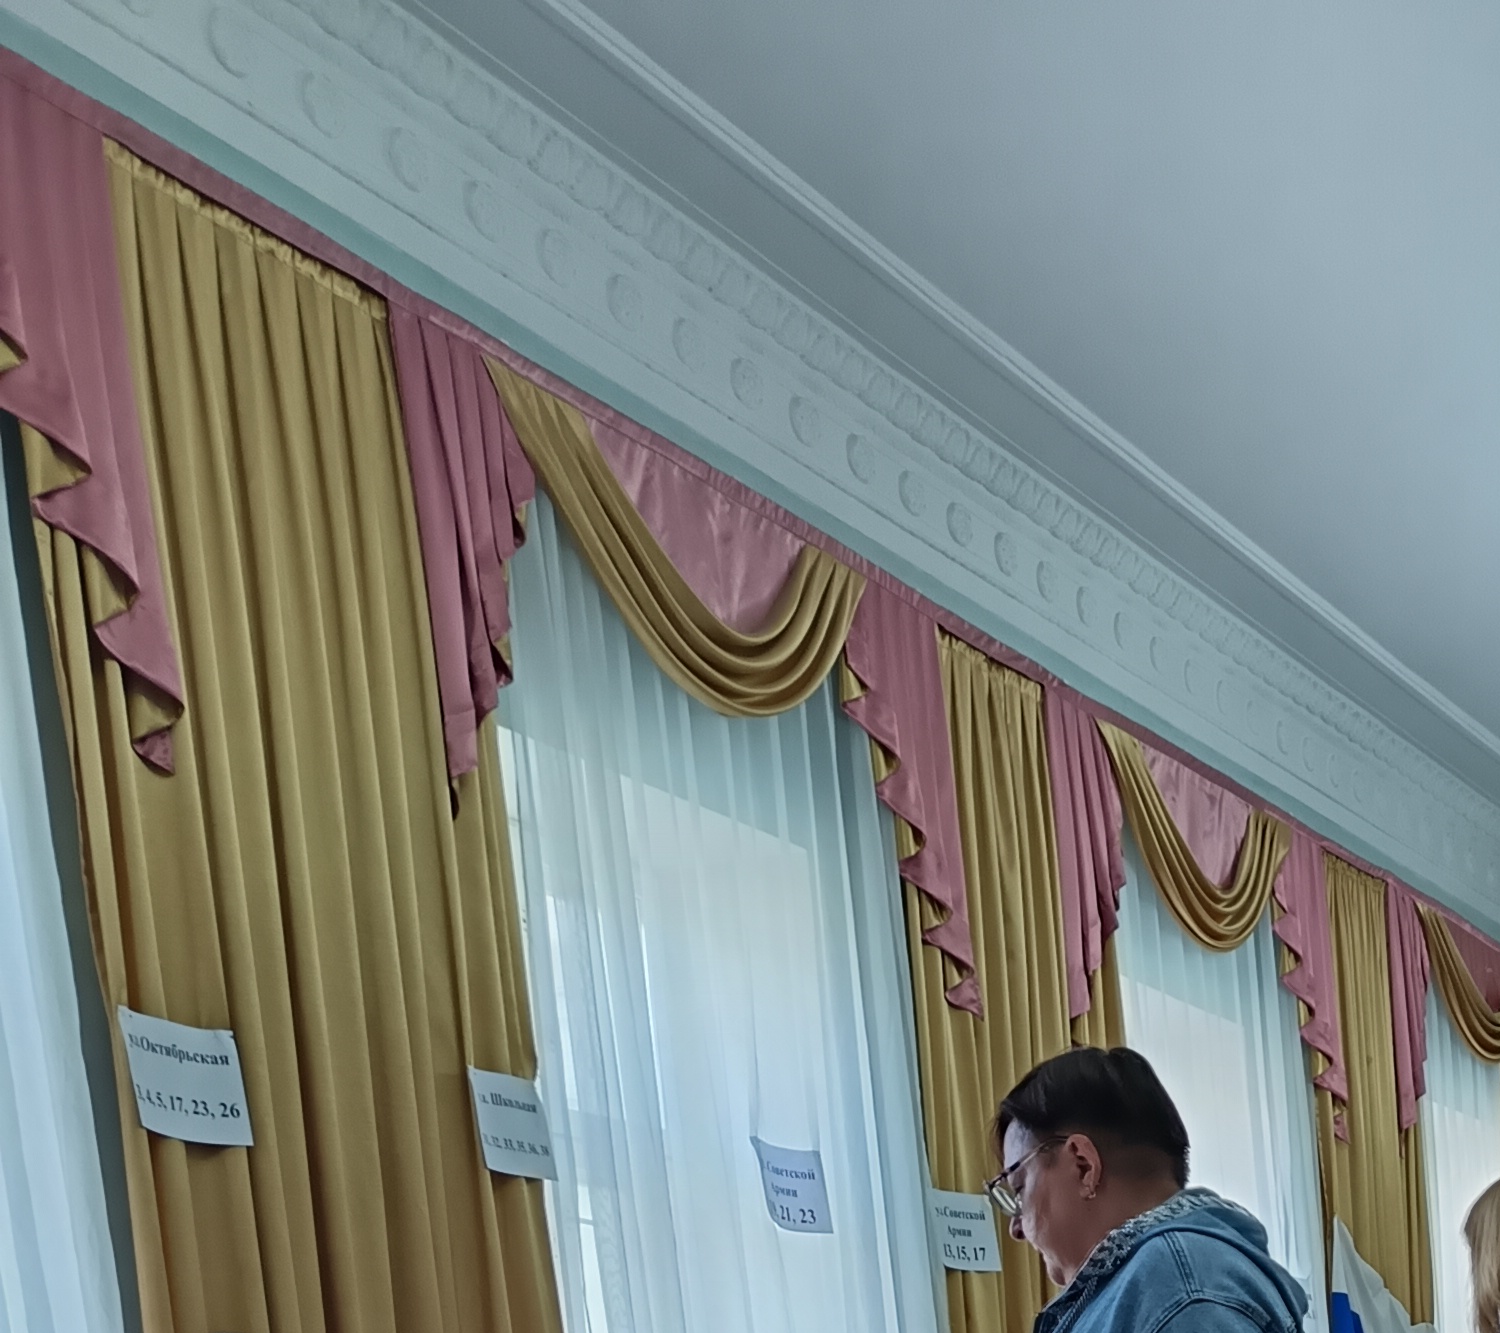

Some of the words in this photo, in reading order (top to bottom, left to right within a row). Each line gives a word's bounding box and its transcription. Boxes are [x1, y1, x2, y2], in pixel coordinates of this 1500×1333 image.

[192, 1099, 216, 1120] 23,
[219, 1102, 241, 1119] 26
[799, 1208, 817, 1225] 23
[973, 1247, 986, 1261] 17
